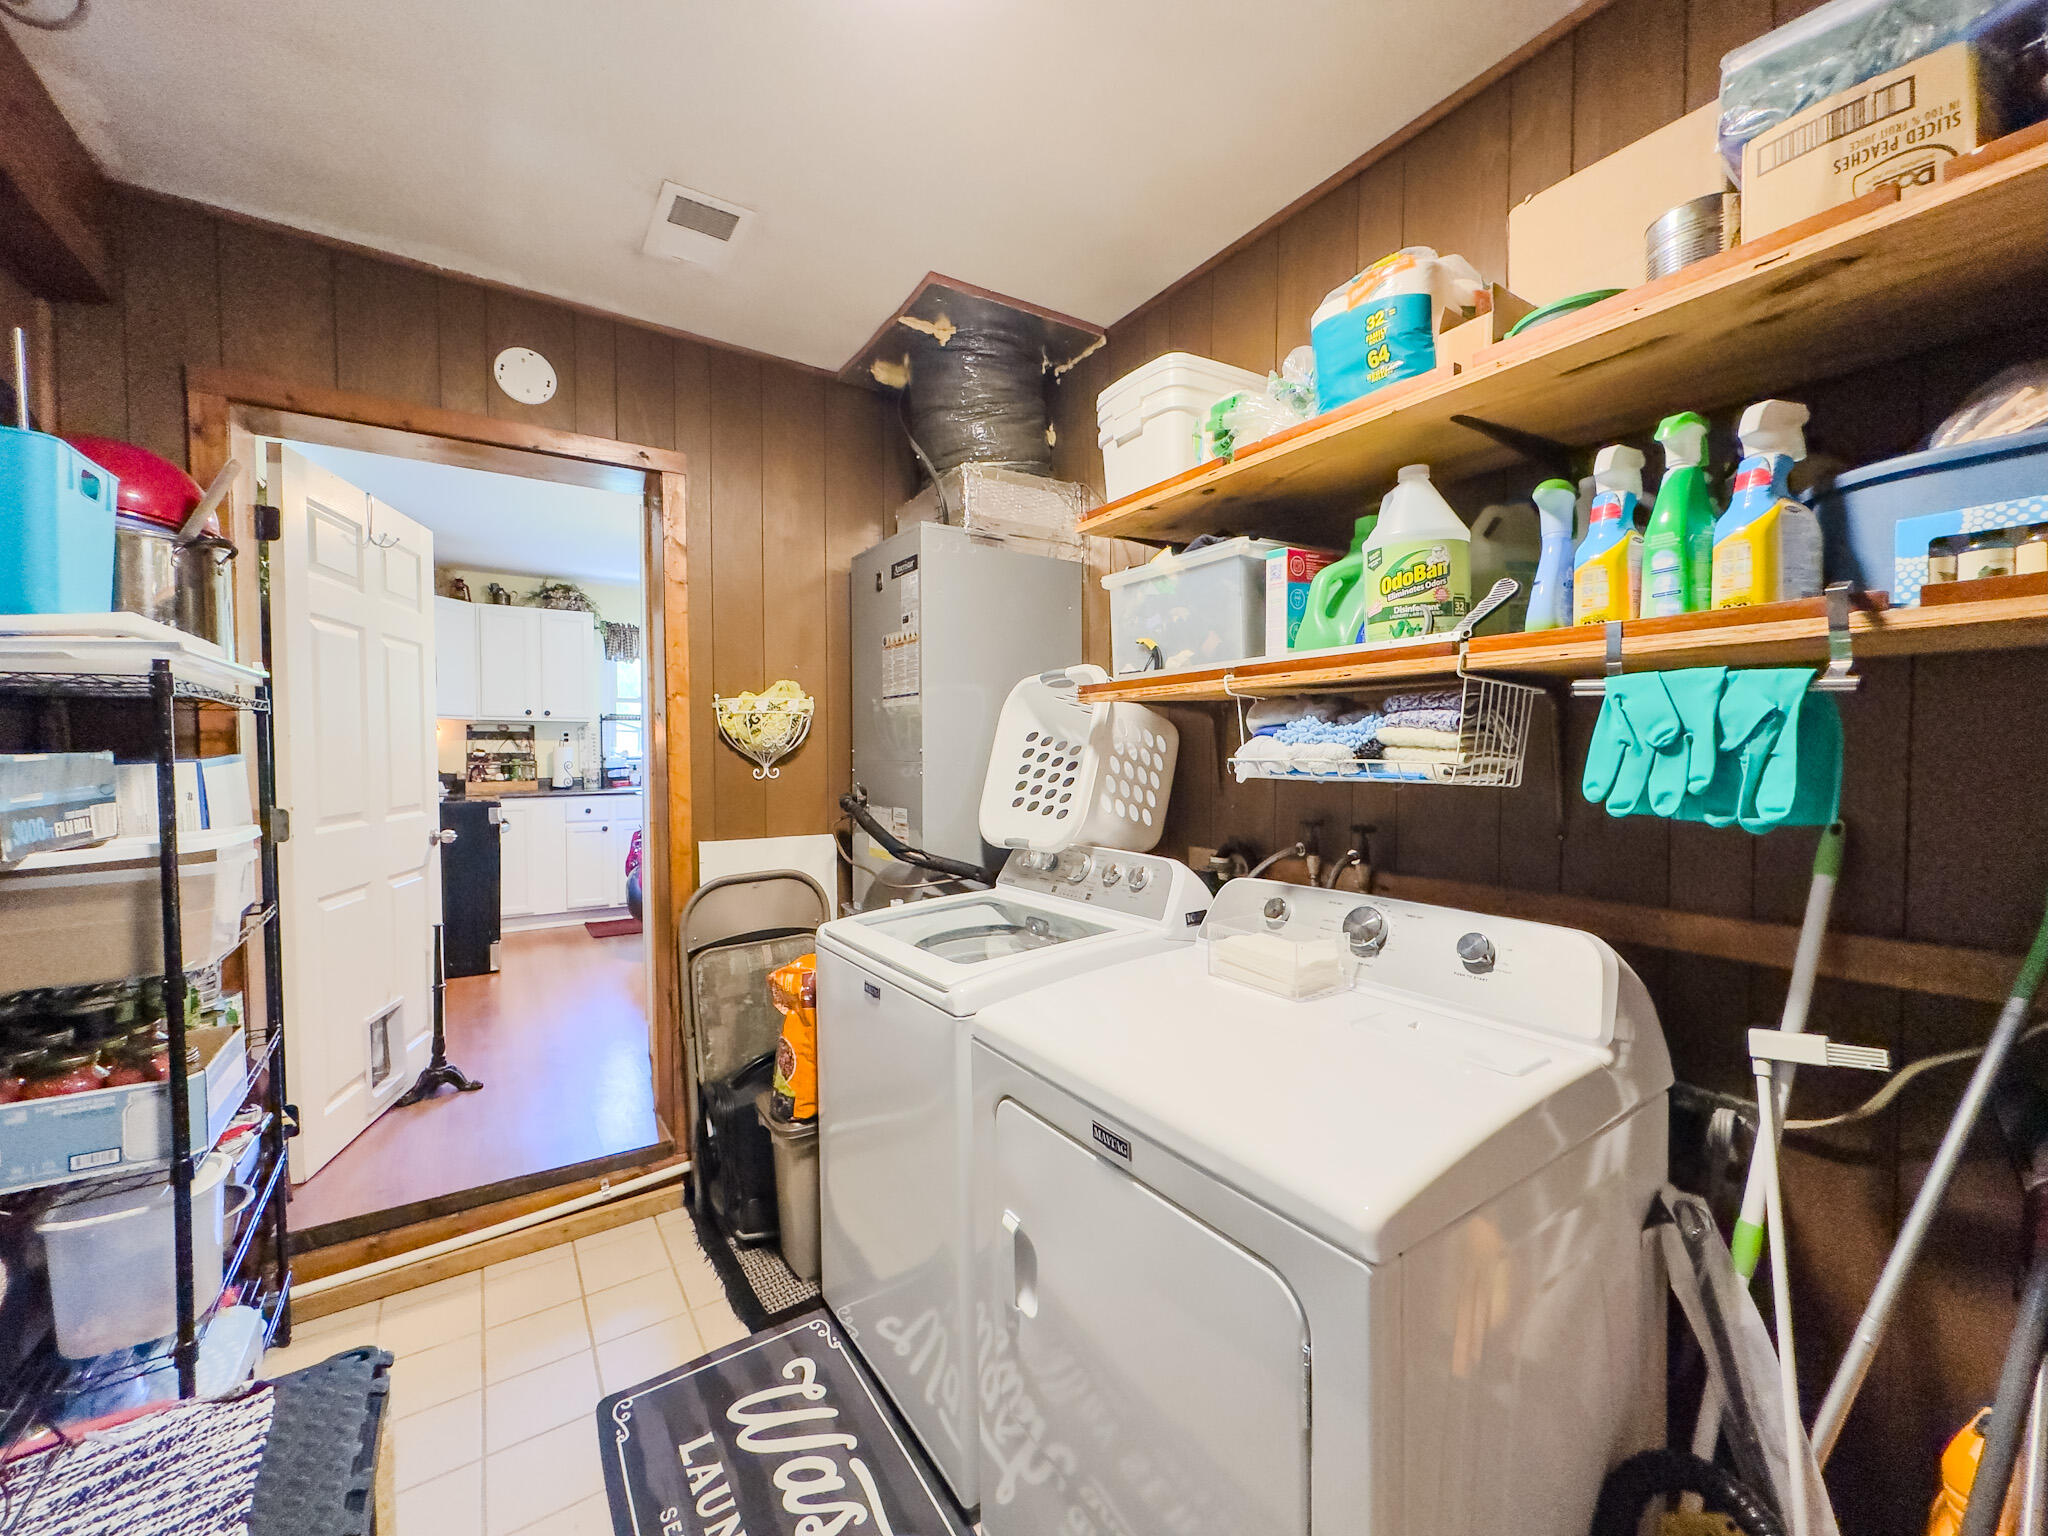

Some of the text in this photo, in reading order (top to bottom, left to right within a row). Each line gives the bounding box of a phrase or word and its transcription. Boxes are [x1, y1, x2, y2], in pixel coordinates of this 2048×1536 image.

[1833, 111, 1961, 175] SLICED PEACHES
[1881, 120, 1907, 139] FRUIT
[1365, 309, 1385, 332] 32
[1366, 343, 1391, 369] 64
[1380, 560, 1449, 596] OdoBan
[1388, 583, 1425, 601] Eliminates
[1425, 577, 1447, 589] Odors
[1454, 601, 1464, 611] 32
[1093, 1125, 1128, 1156] MAYTAG
[726, 1357, 895, 1536] Was
[659, 1506, 686, 1536] SE
